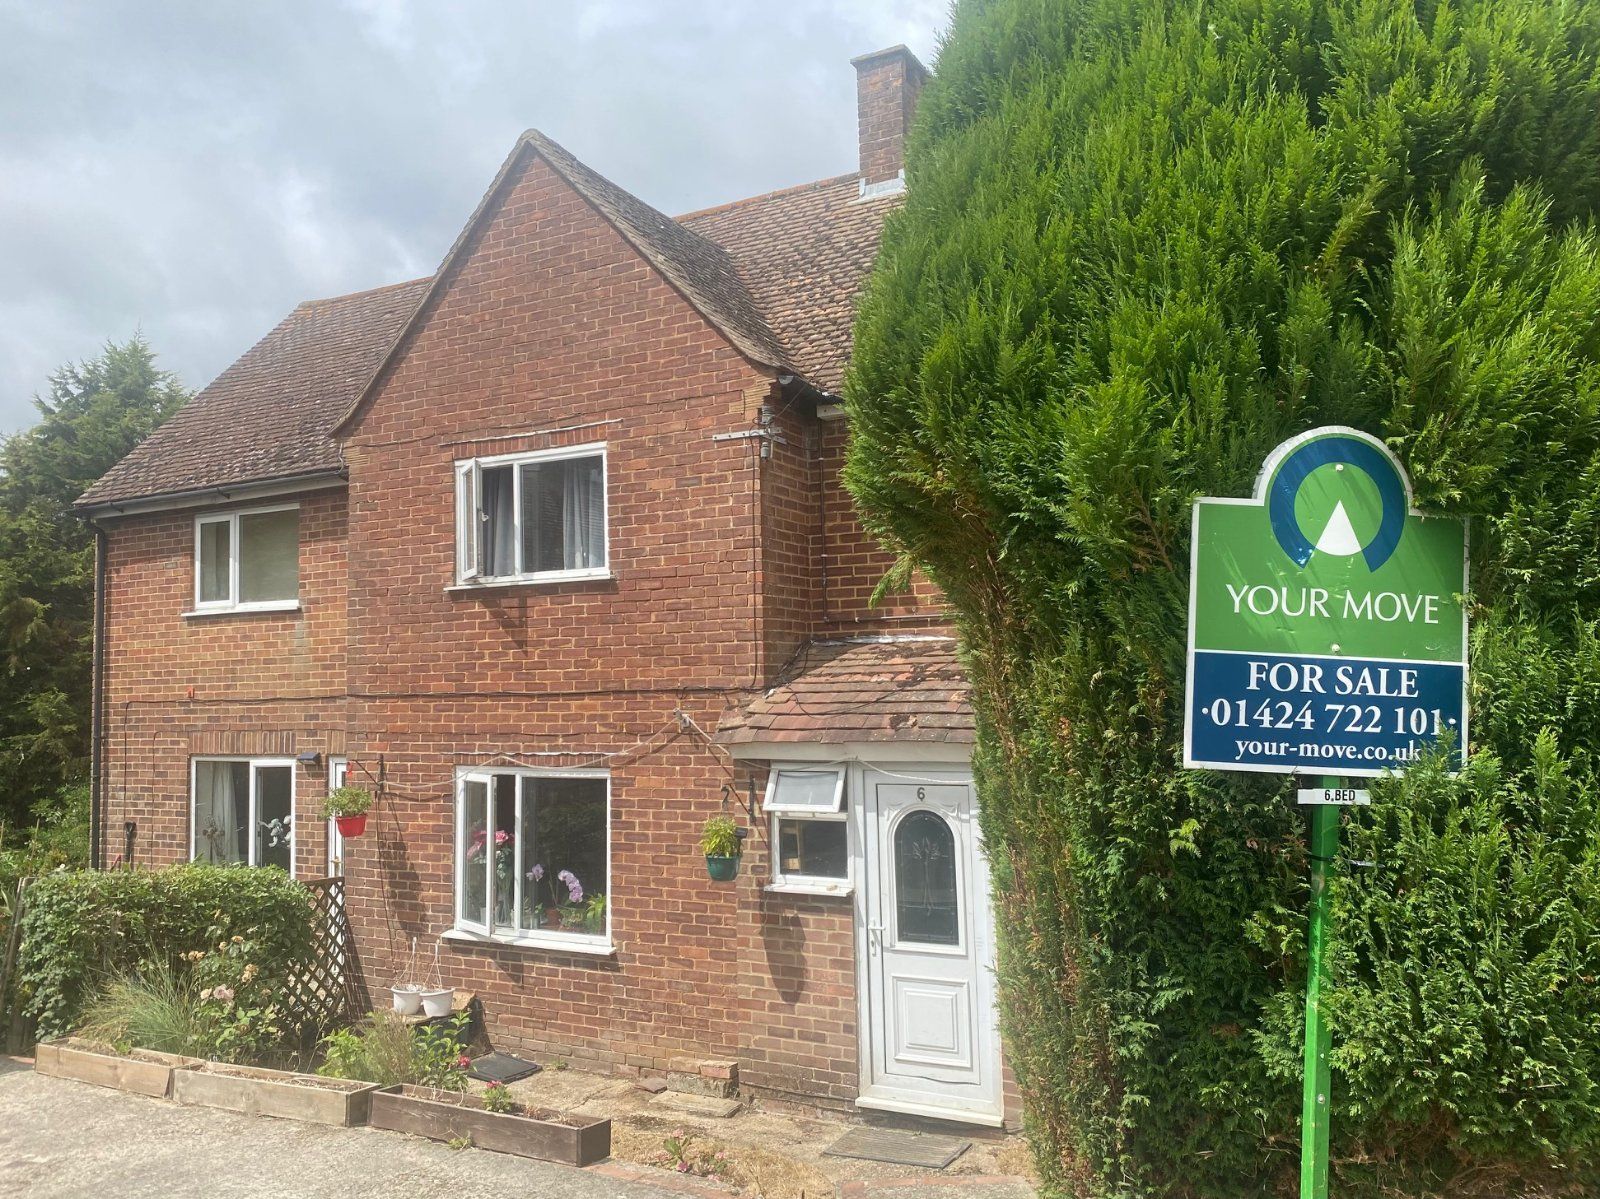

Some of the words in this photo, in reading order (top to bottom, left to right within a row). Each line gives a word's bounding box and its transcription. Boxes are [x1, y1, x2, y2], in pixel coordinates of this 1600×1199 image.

[1225, 583, 1331, 618] YOUR
[1342, 589, 1440, 625] MOVE
[1246, 661, 1327, 694] FOR
[1334, 666, 1419, 698] SALE
[1210, 697, 1316, 731] 01424
[1323, 703, 1383, 733] 722
[1393, 706, 1443, 736] 101
[1234, 738, 1422, 762] your-move.co.uk
[916, 786, 926, 801] 6
[1324, 789, 1356, 802] 6.BED
